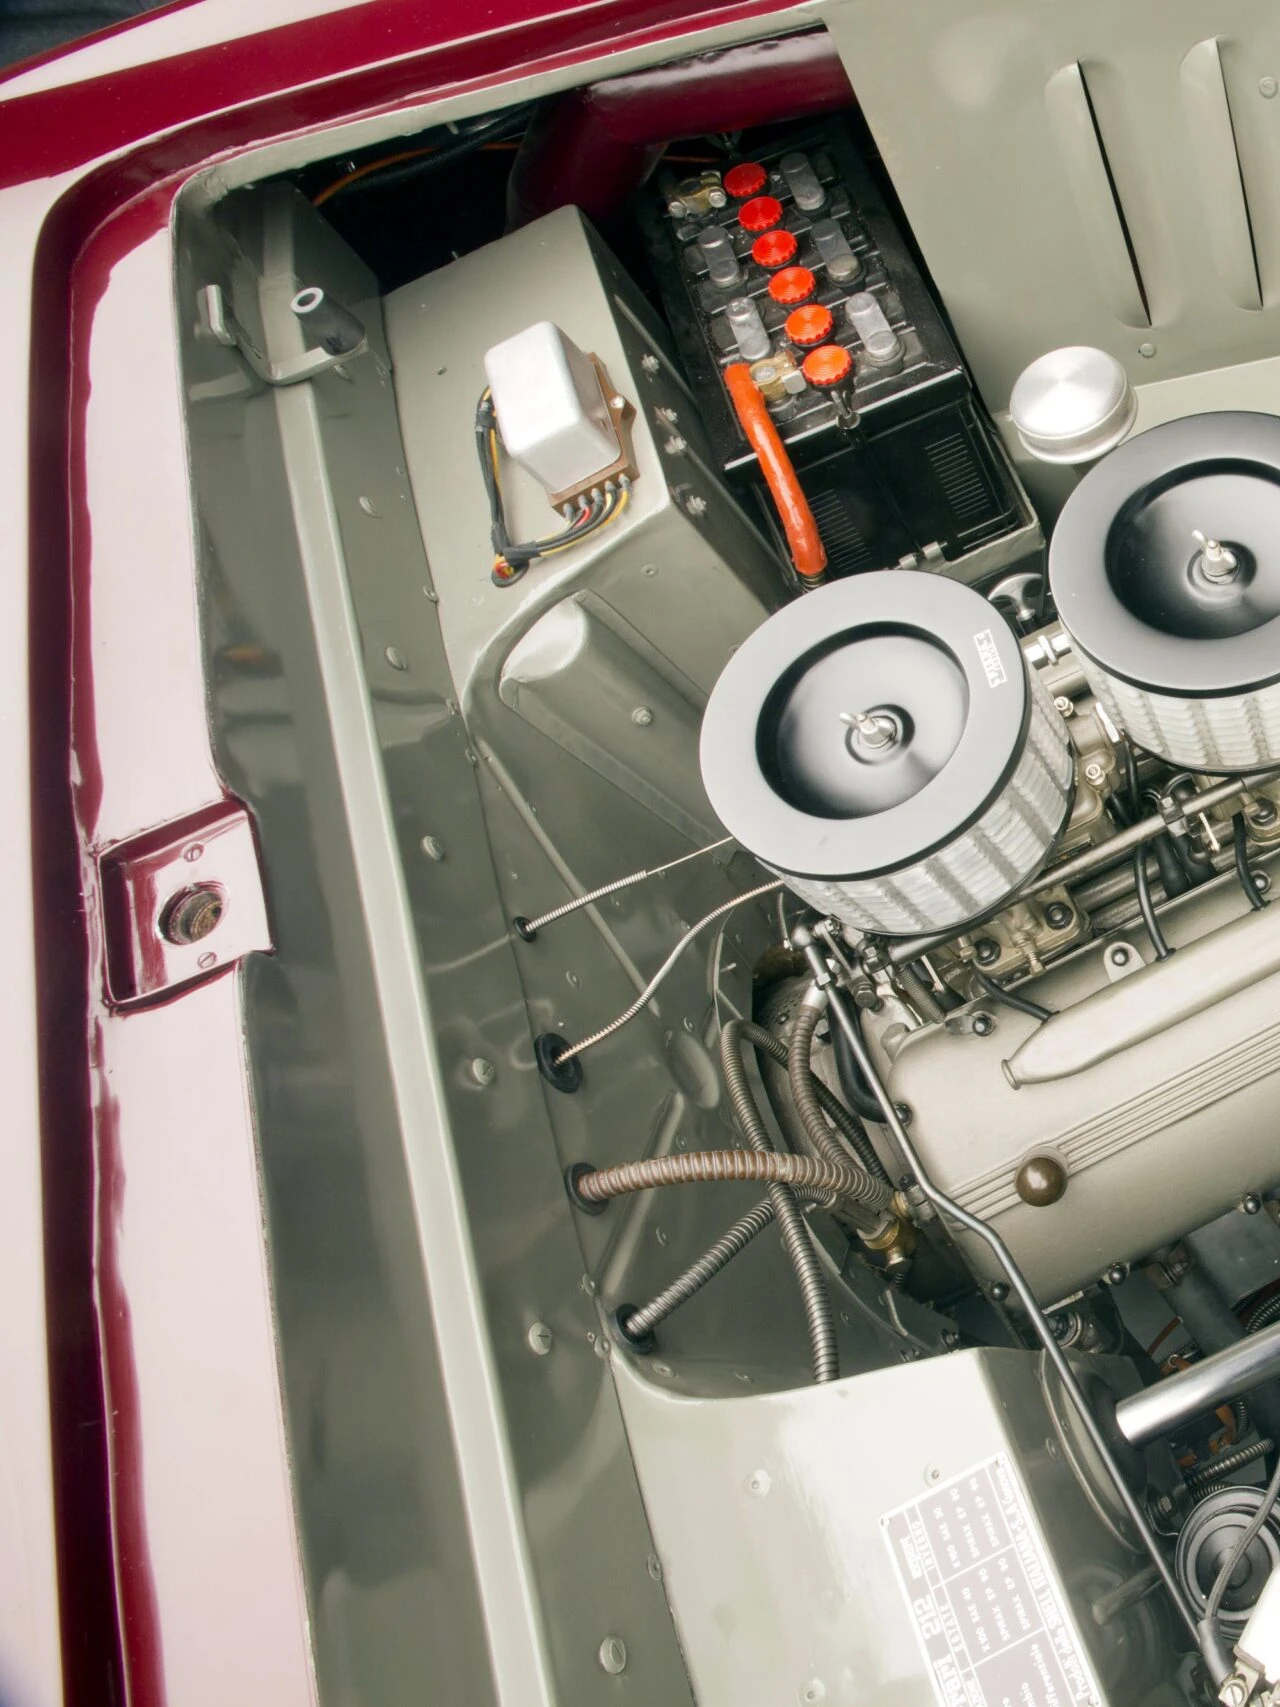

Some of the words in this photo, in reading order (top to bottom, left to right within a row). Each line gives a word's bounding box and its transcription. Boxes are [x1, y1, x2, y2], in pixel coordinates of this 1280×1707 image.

[955, 1505, 967, 1519] EP
[974, 1494, 987, 1508] EP
[911, 1519, 935, 1570] INVERNO
[938, 1522, 951, 1540] SAE
[961, 1523, 980, 1558] SPIRAX
[981, 1512, 1000, 1547] SPIRAX
[984, 1586, 997, 1600] EP
[1003, 1574, 1016, 1589] EP
[912, 1594, 942, 1639] 212
[939, 1602, 963, 1651] ESTATE
[967, 1603, 980, 1622] SAE
[991, 1605, 1011, 1641] SPIRAX
[1011, 1593, 1031, 1630] SPIRAX
[1035, 1588, 1063, 1630] SHELL
[1028, 1642, 1060, 1705] ifferenziale
